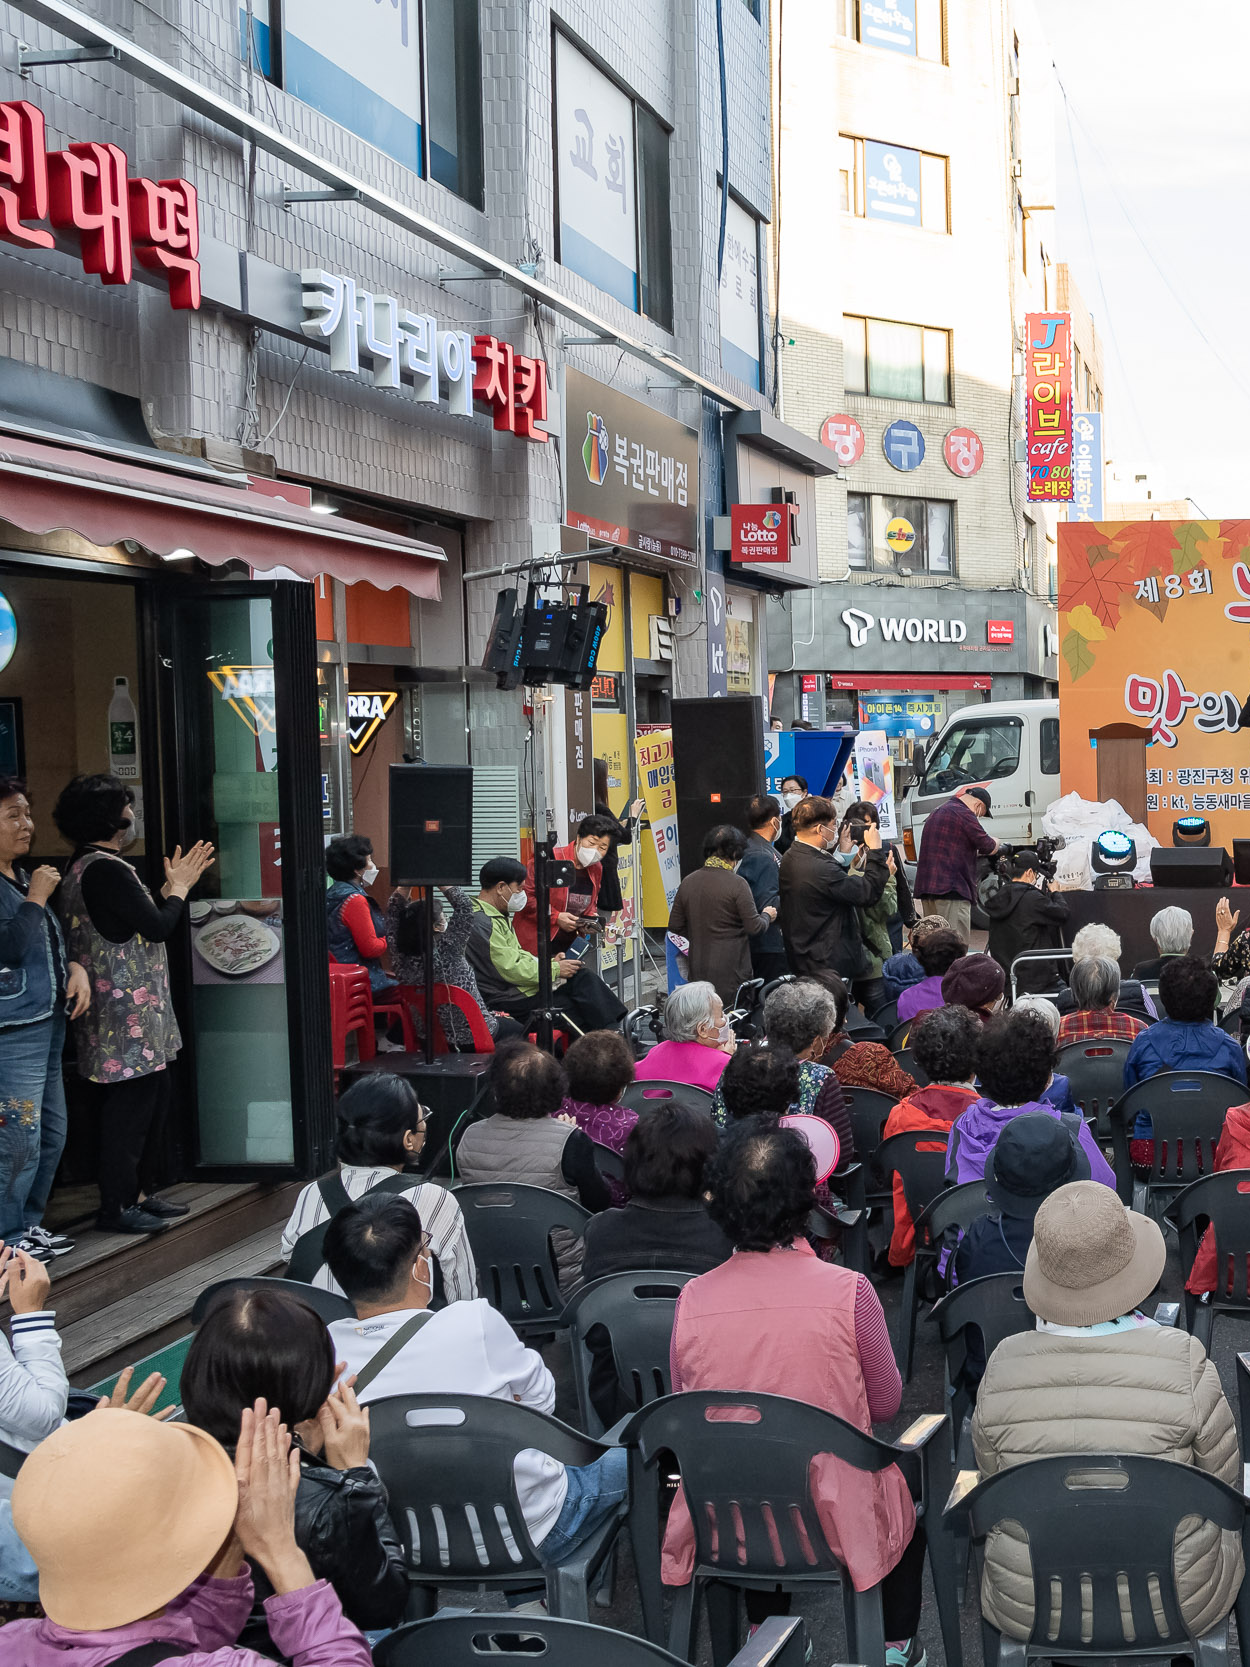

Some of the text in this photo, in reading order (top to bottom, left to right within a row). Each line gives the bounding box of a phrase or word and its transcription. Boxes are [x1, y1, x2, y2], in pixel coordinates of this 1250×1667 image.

[1031, 437, 1069, 462] cafe
[613, 433, 688, 507] 복권판매점
[740, 530, 778, 542] Lotto
[741, 546, 778, 555] 복권판매점
[879, 617, 967, 643] WORLD
[712, 643, 724, 674] kt
[1177, 768, 1234, 785] 광진구청
